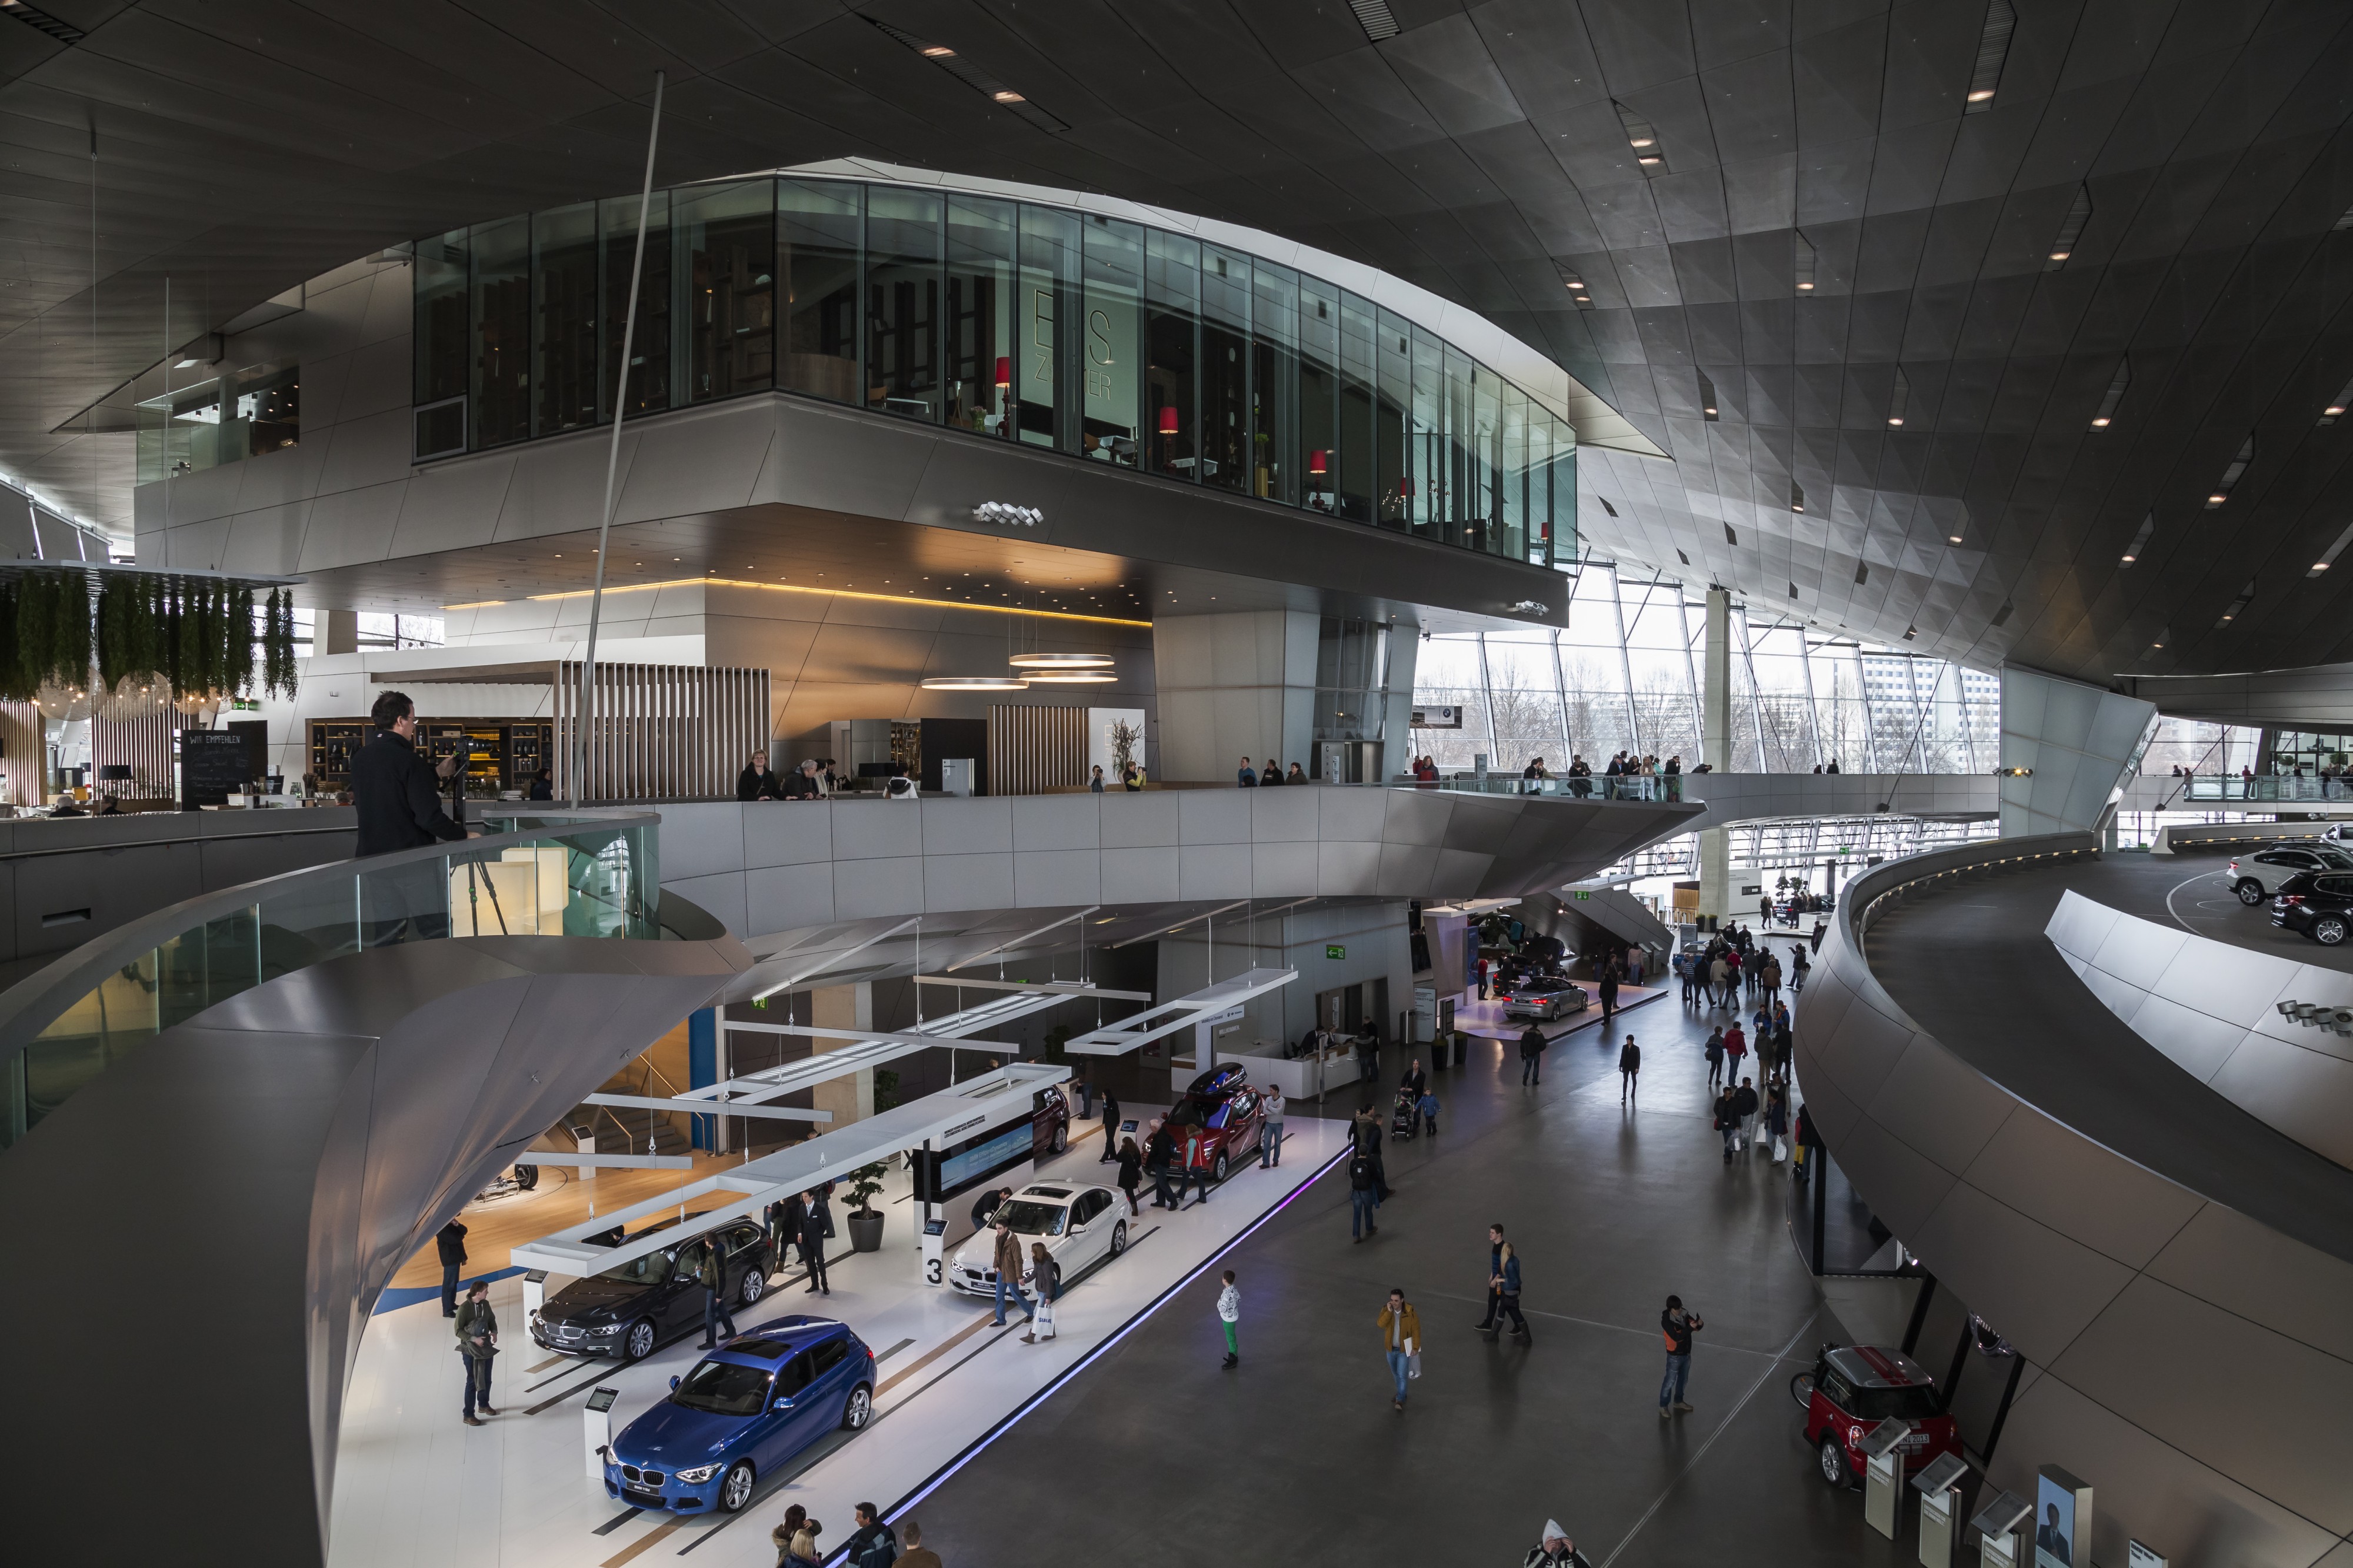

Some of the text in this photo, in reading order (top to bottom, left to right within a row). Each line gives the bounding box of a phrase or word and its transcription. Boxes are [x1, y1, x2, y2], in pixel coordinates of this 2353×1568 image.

[1035, 289, 1111, 366] ES
[189, 735, 241, 745] WIR EMPFEHLEN
[969, 1154, 979, 1162] BMW
[927, 1259, 942, 1284] 3
[2131, 1543, 2154, 1562] BMW Welt
